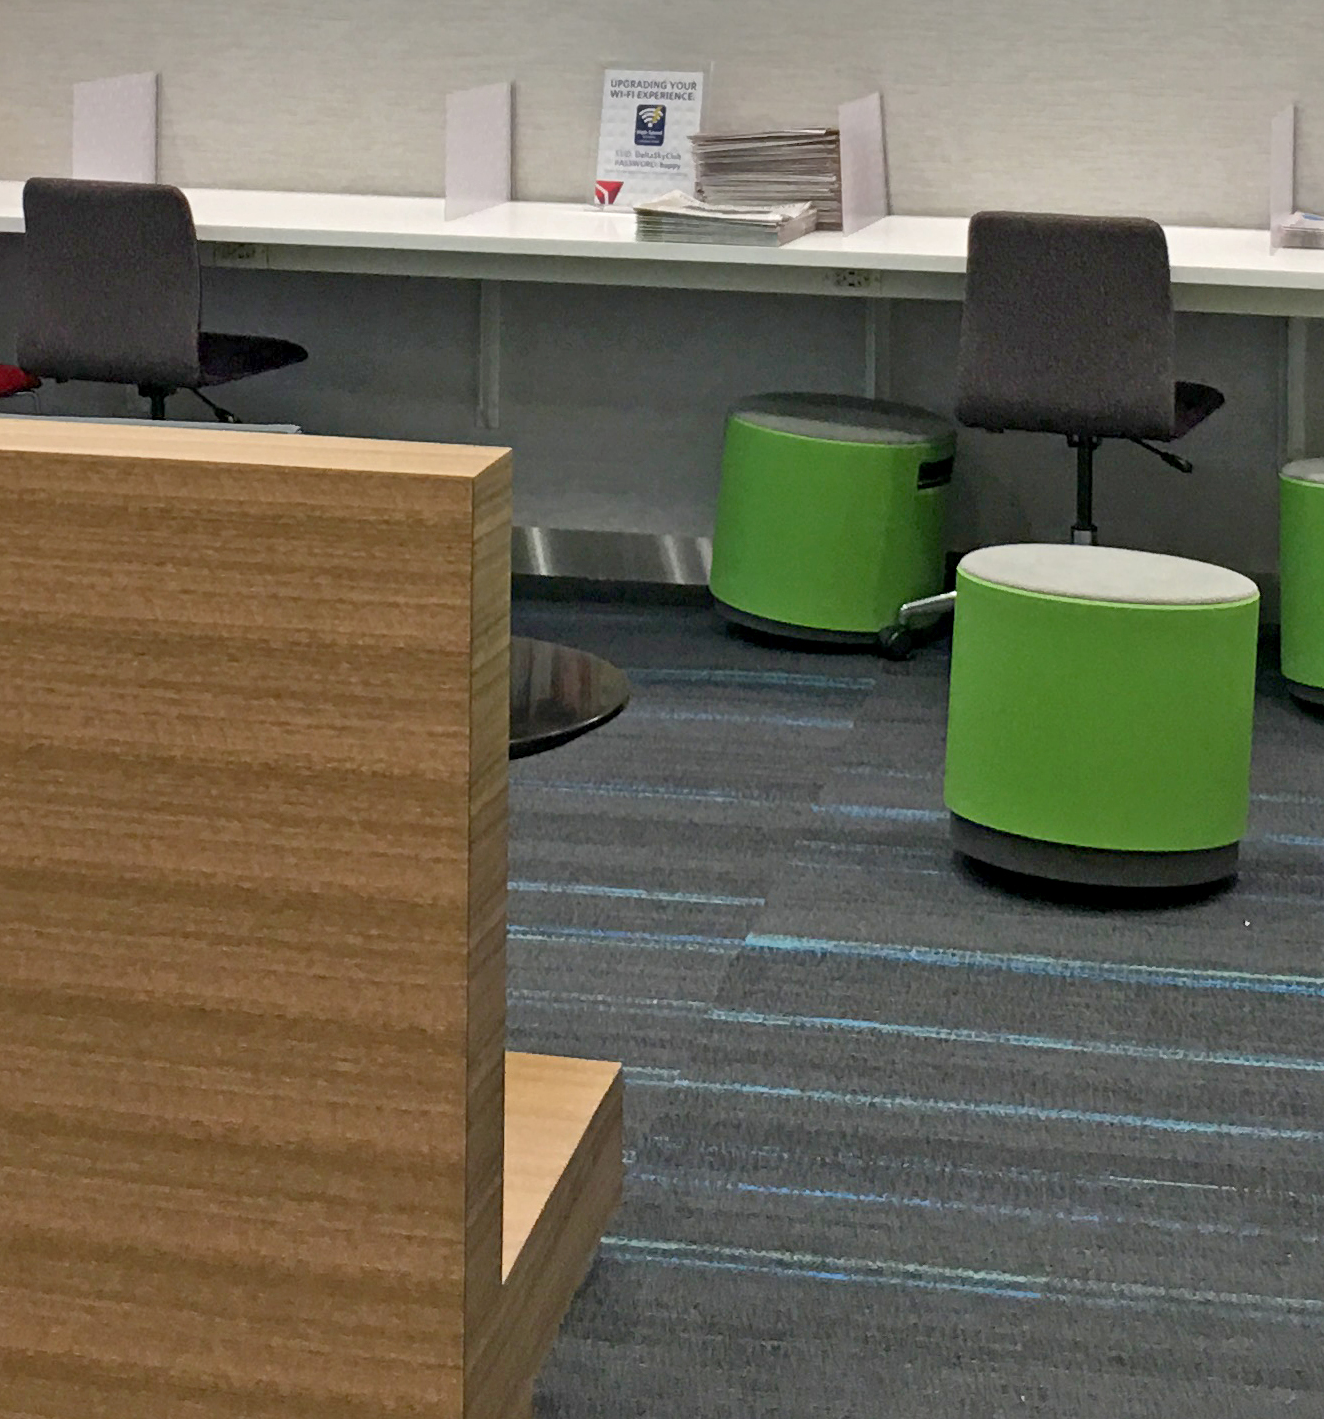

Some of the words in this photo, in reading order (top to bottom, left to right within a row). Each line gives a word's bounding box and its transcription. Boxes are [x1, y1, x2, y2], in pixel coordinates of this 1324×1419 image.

[610, 79, 667, 90] UPGRADING
[670, 80, 697, 91] YOUR
[610, 89, 635, 99] WI-FI
[636, 90, 695, 101] EXPERIENCE.
